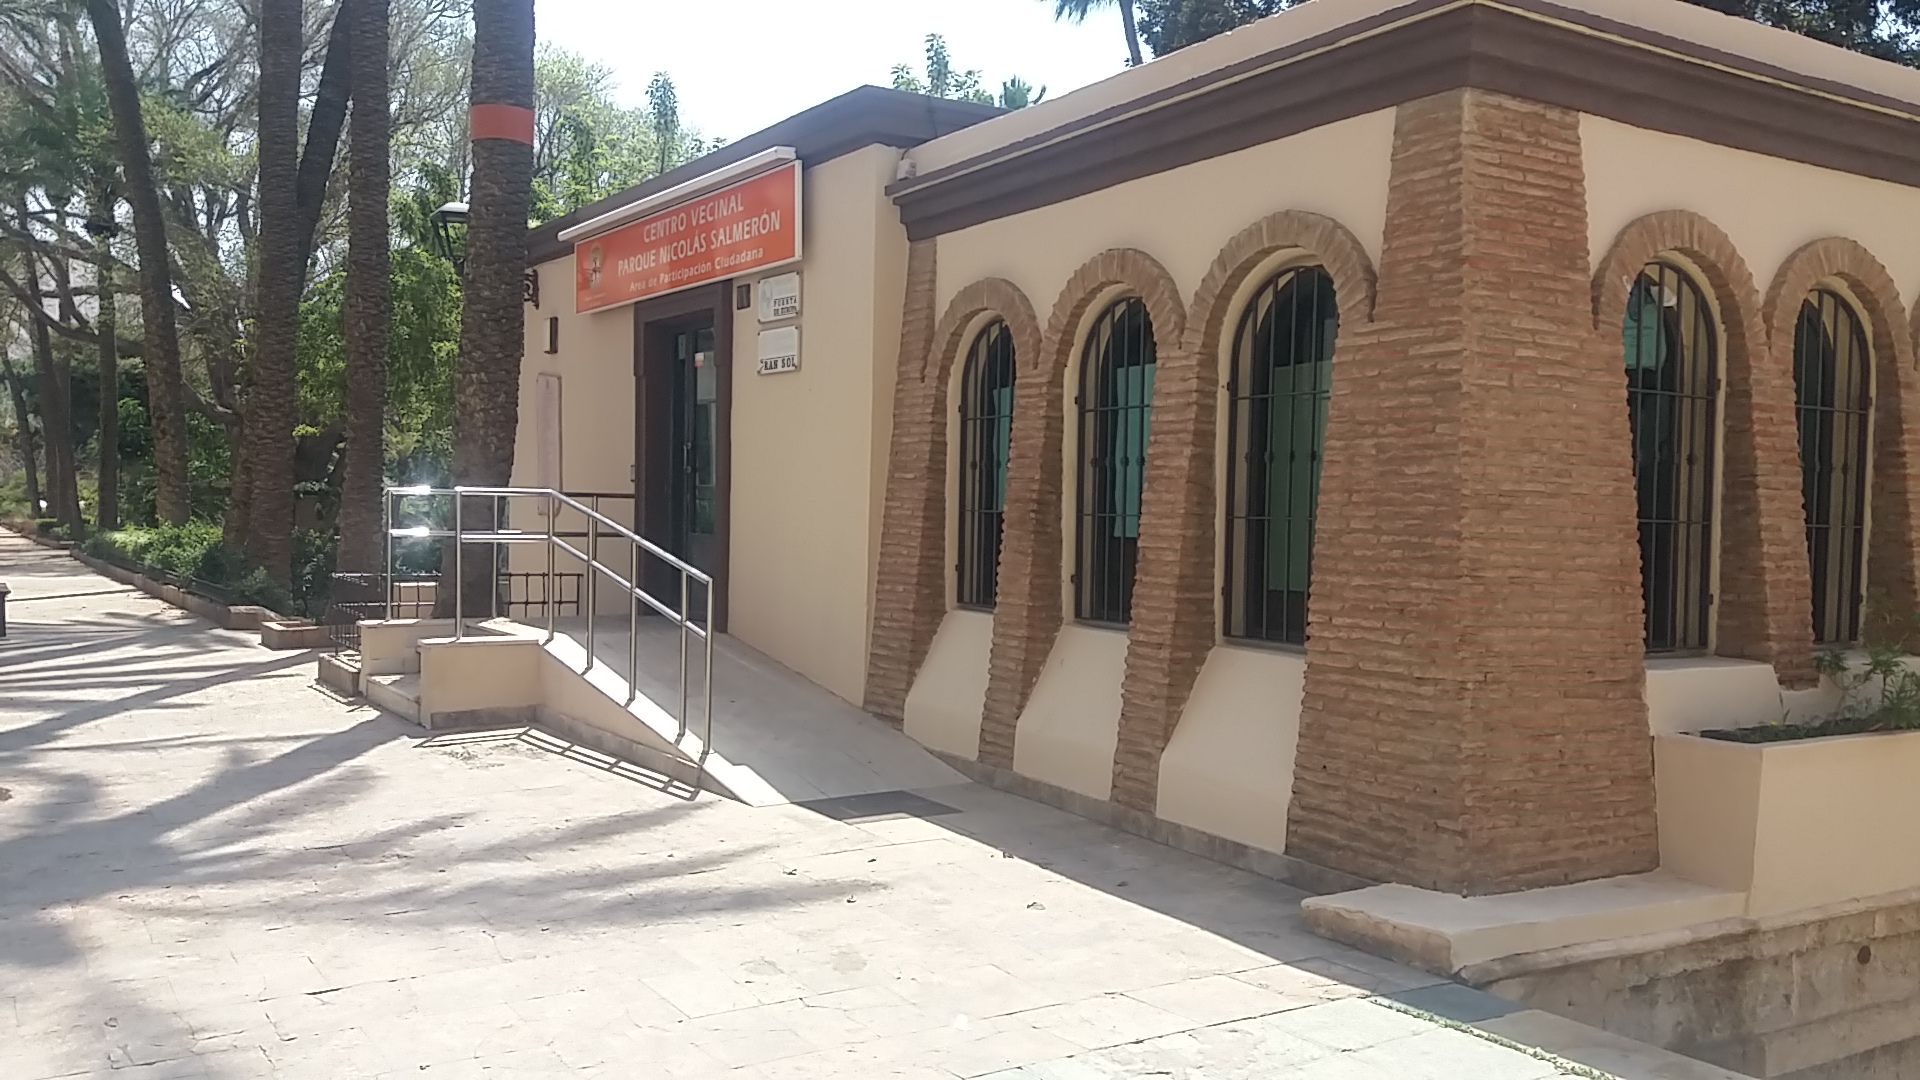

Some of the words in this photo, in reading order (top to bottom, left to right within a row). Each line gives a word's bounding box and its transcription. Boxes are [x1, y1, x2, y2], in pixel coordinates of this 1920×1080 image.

[643, 212, 687, 243] CENTRO
[691, 192, 744, 227] VECINAL
[618, 249, 656, 276] PARQUE
[659, 230, 707, 264] NICOLÁS
[710, 208, 781, 249] SALMERÓN
[648, 277, 657, 288] de
[660, 261, 712, 284] Participación
[714, 248, 763, 270] Ciudadana
[781, 357, 796, 369] SOL
